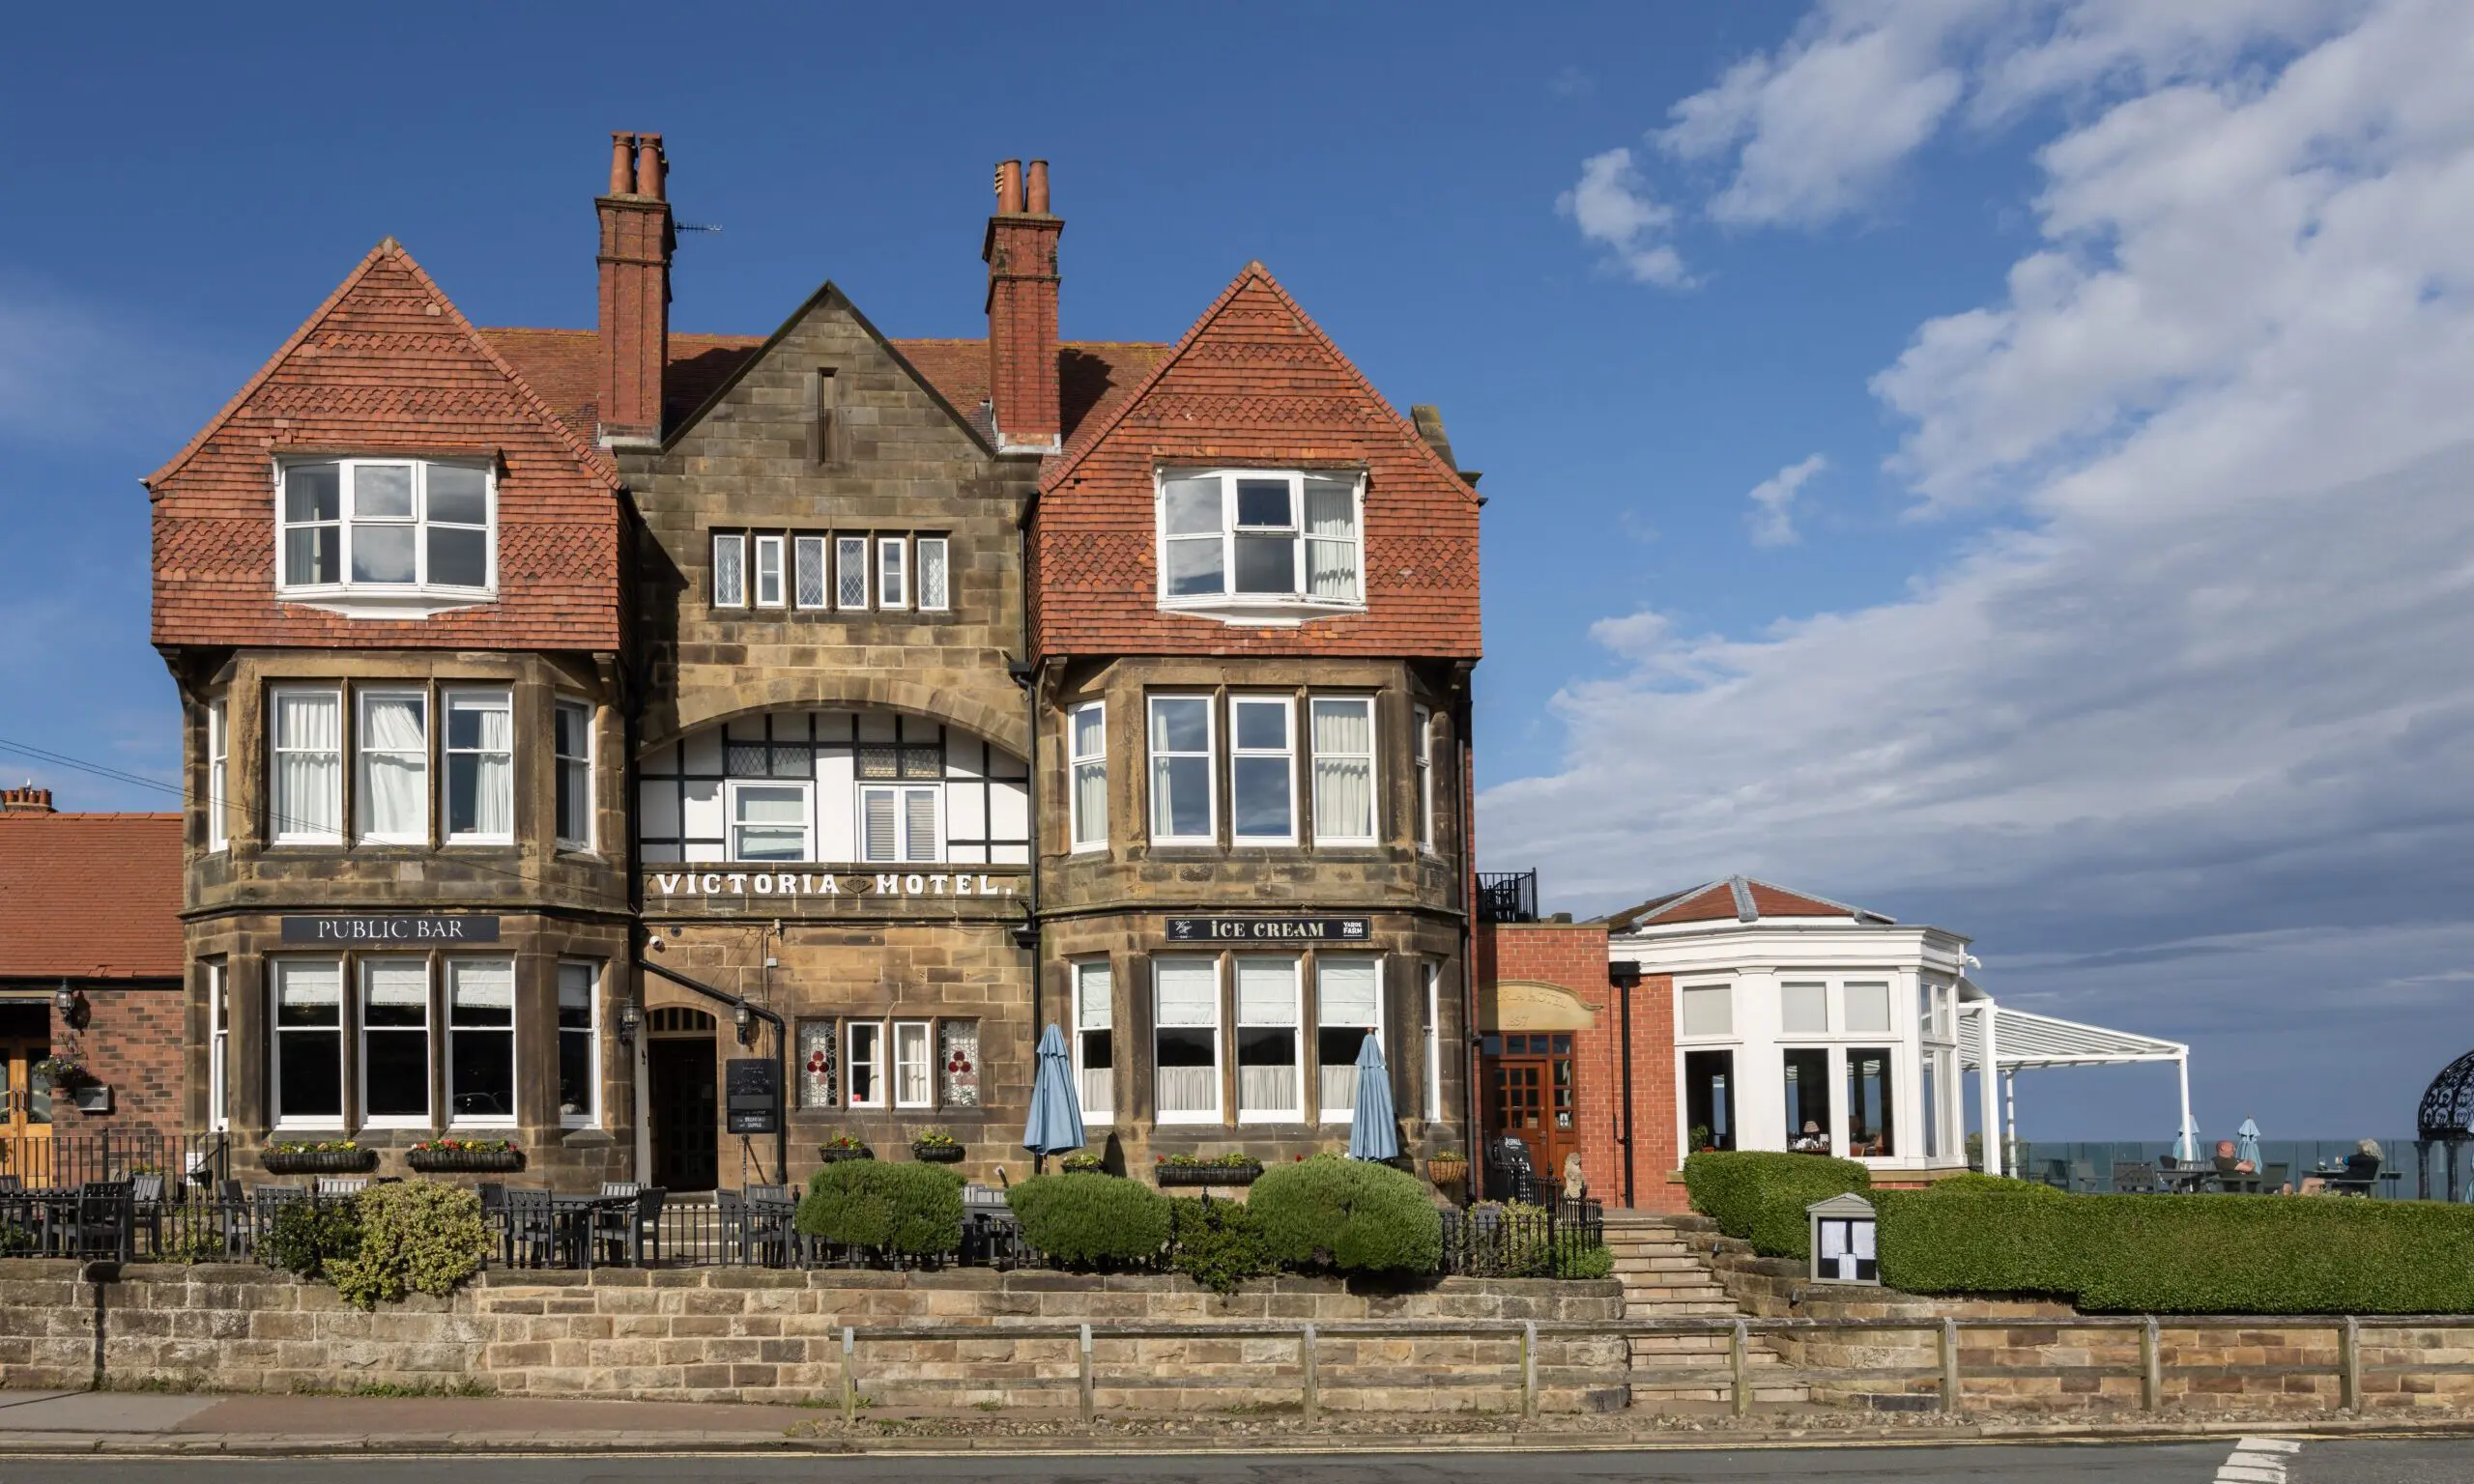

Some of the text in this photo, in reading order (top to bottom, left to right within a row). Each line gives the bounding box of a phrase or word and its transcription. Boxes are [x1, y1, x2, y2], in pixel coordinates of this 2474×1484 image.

[656, 873, 840, 894] VICTORIA
[317, 921, 464, 938] PUBLIC BAR
[1253, 923, 1324, 937] CREAM
